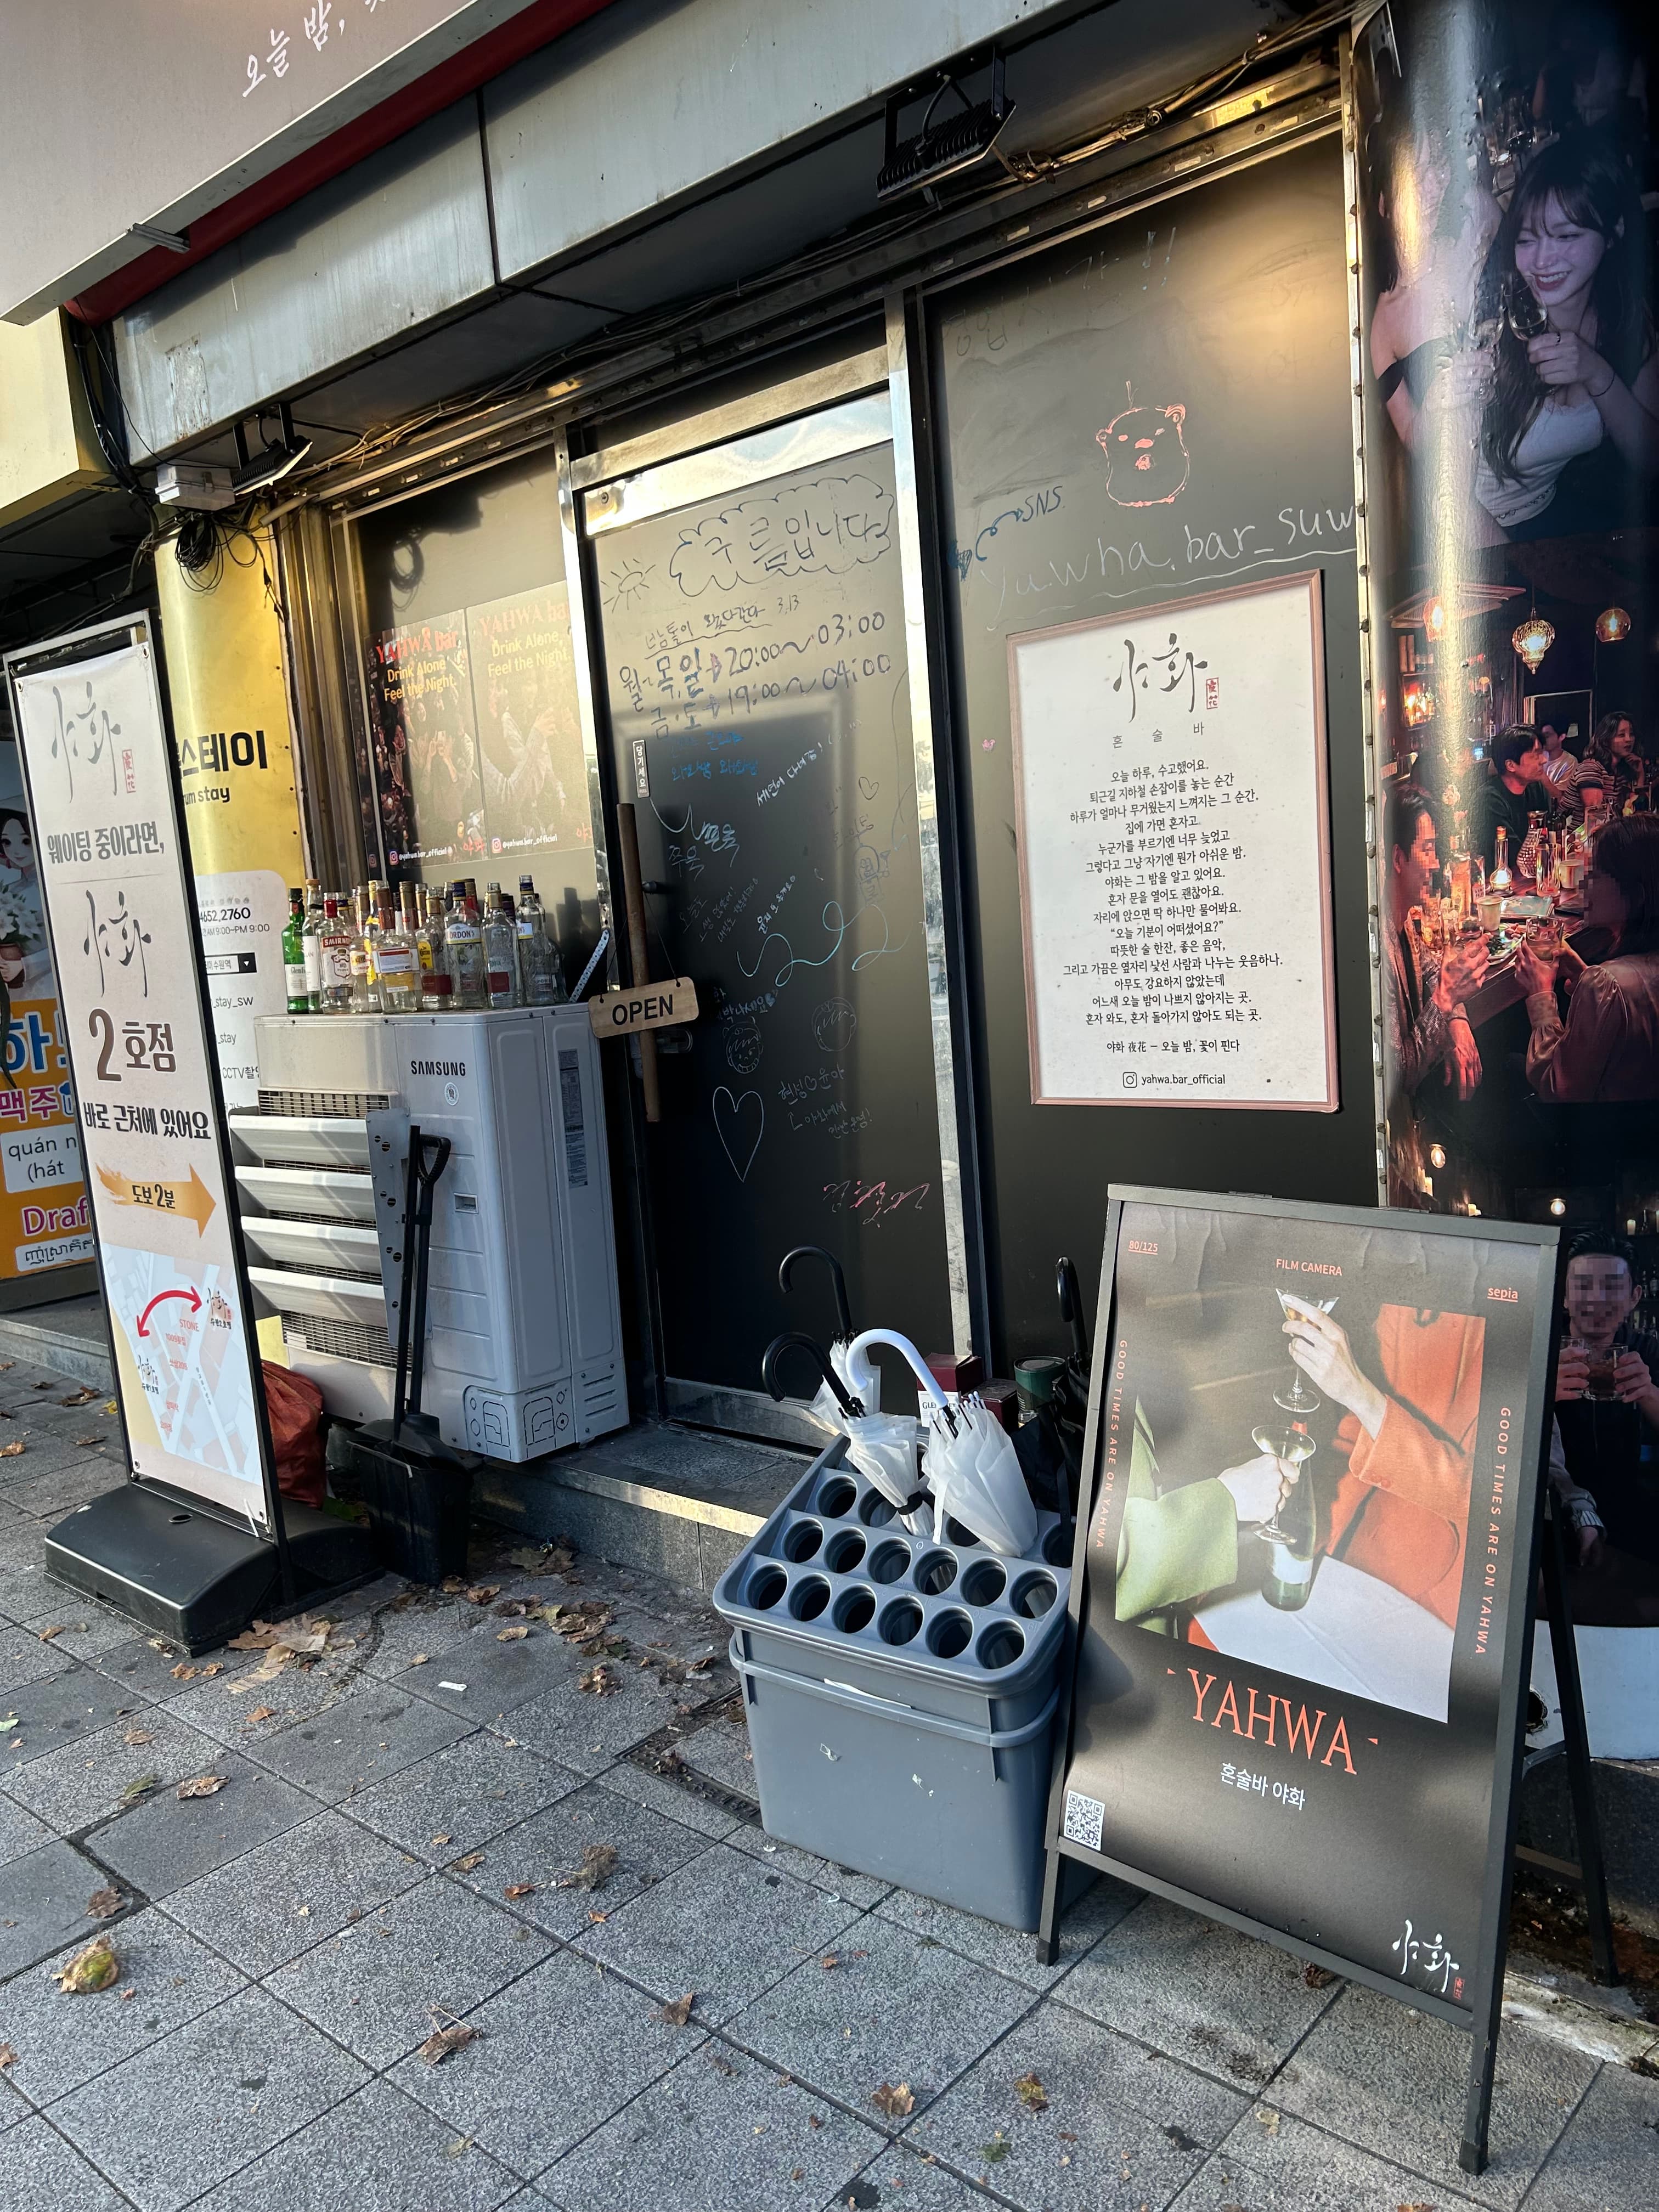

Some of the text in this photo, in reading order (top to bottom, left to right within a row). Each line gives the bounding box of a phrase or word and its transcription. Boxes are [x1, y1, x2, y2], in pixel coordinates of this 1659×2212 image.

[242, 29, 290, 98] 오늘
[492, 639, 522, 657] Drink
[388, 665, 415, 683] Drink
[488, 662, 512, 678] Feel
[515, 657, 534, 672] the
[384, 675, 457, 702] Feel the Night.
[177, 730, 268, 780] 스테이
[1110, 759, 1209, 783] 오늘 하루, 수고했어요.
[198, 786, 230, 803] stay
[1090, 772, 1235, 804] 퇴근길 지하철 손잡이를 놓는 순간
[1070, 788, 1259, 824] 하루가 얼마나 무거웠는지 느껴지는 그 순간.
[1125, 820, 1144, 836] 집에
[1147, 817, 1166, 832] 가면
[47, 821, 165, 865] 웨이팅 중이라면,
[1098, 829, 1231, 856] 누군가를 부르기엔 너무 늦었고
[1085, 845, 1246, 873] 그렇다고 그냥 자기엔 뭔가 아쉬운 밤.
[1105, 866, 1226, 889] 야화는 그 밤을 알고 있어요.
[1108, 885, 1224, 906] 혼자 문을 열어도 괜찮아요.
[1093, 901, 1242, 924] 자리에 앉으면 딱 하나만 물어봐요.
[1136, 924, 1164, 939] 기분이
[1110, 938, 1226, 957] 따뜻한 술 한잔, 좋은 음악,
[1063, 952, 1283, 976] 그리고 가끔은 옆자리 낯선 사람과 나누는 웃음하나.
[1114, 973, 1224, 991] 아무도 강요하지 않았는데
[612, 994, 674, 1026] OPEN
[1092, 991, 1251, 1008] 어느새 오늘 밤이 나쁘지 않아지는 곳.
[1085, 1008, 1262, 1025] 혼자 와도, 혼자 돌아가지 않아도 되는 곳.
[1107, 1039, 1240, 1053] 야화 夜花 오늘 밤, 꽃이 핀다
[410, 1060, 466, 1077] SAMSUNG
[1141, 1074, 1226, 1086] yahwa.bar_official
[0, 1086, 55, 1122] 맥주
[83, 1101, 211, 1140] 바로 근처에 있어요
[8, 1136, 57, 1163] quán
[27, 1160, 65, 1183] (hát
[132, 1183, 176, 1209] 도보 2분
[1128, 1239, 1158, 1254] 80/125
[1276, 1259, 1342, 1277] FILM CAMERA
[1487, 1286, 1519, 1302] sepia
[179, 1319, 200, 1332] STONE
[1096, 1340, 1127, 1548] GOOD TIMES ARE ON YAHWA
[1475, 1408, 1511, 1654] GOOD TIMES ARE ON YAHWA
[1187, 1668, 1357, 1775] YAHWA
[1220, 1762, 1306, 1810] 혼술바 야화
